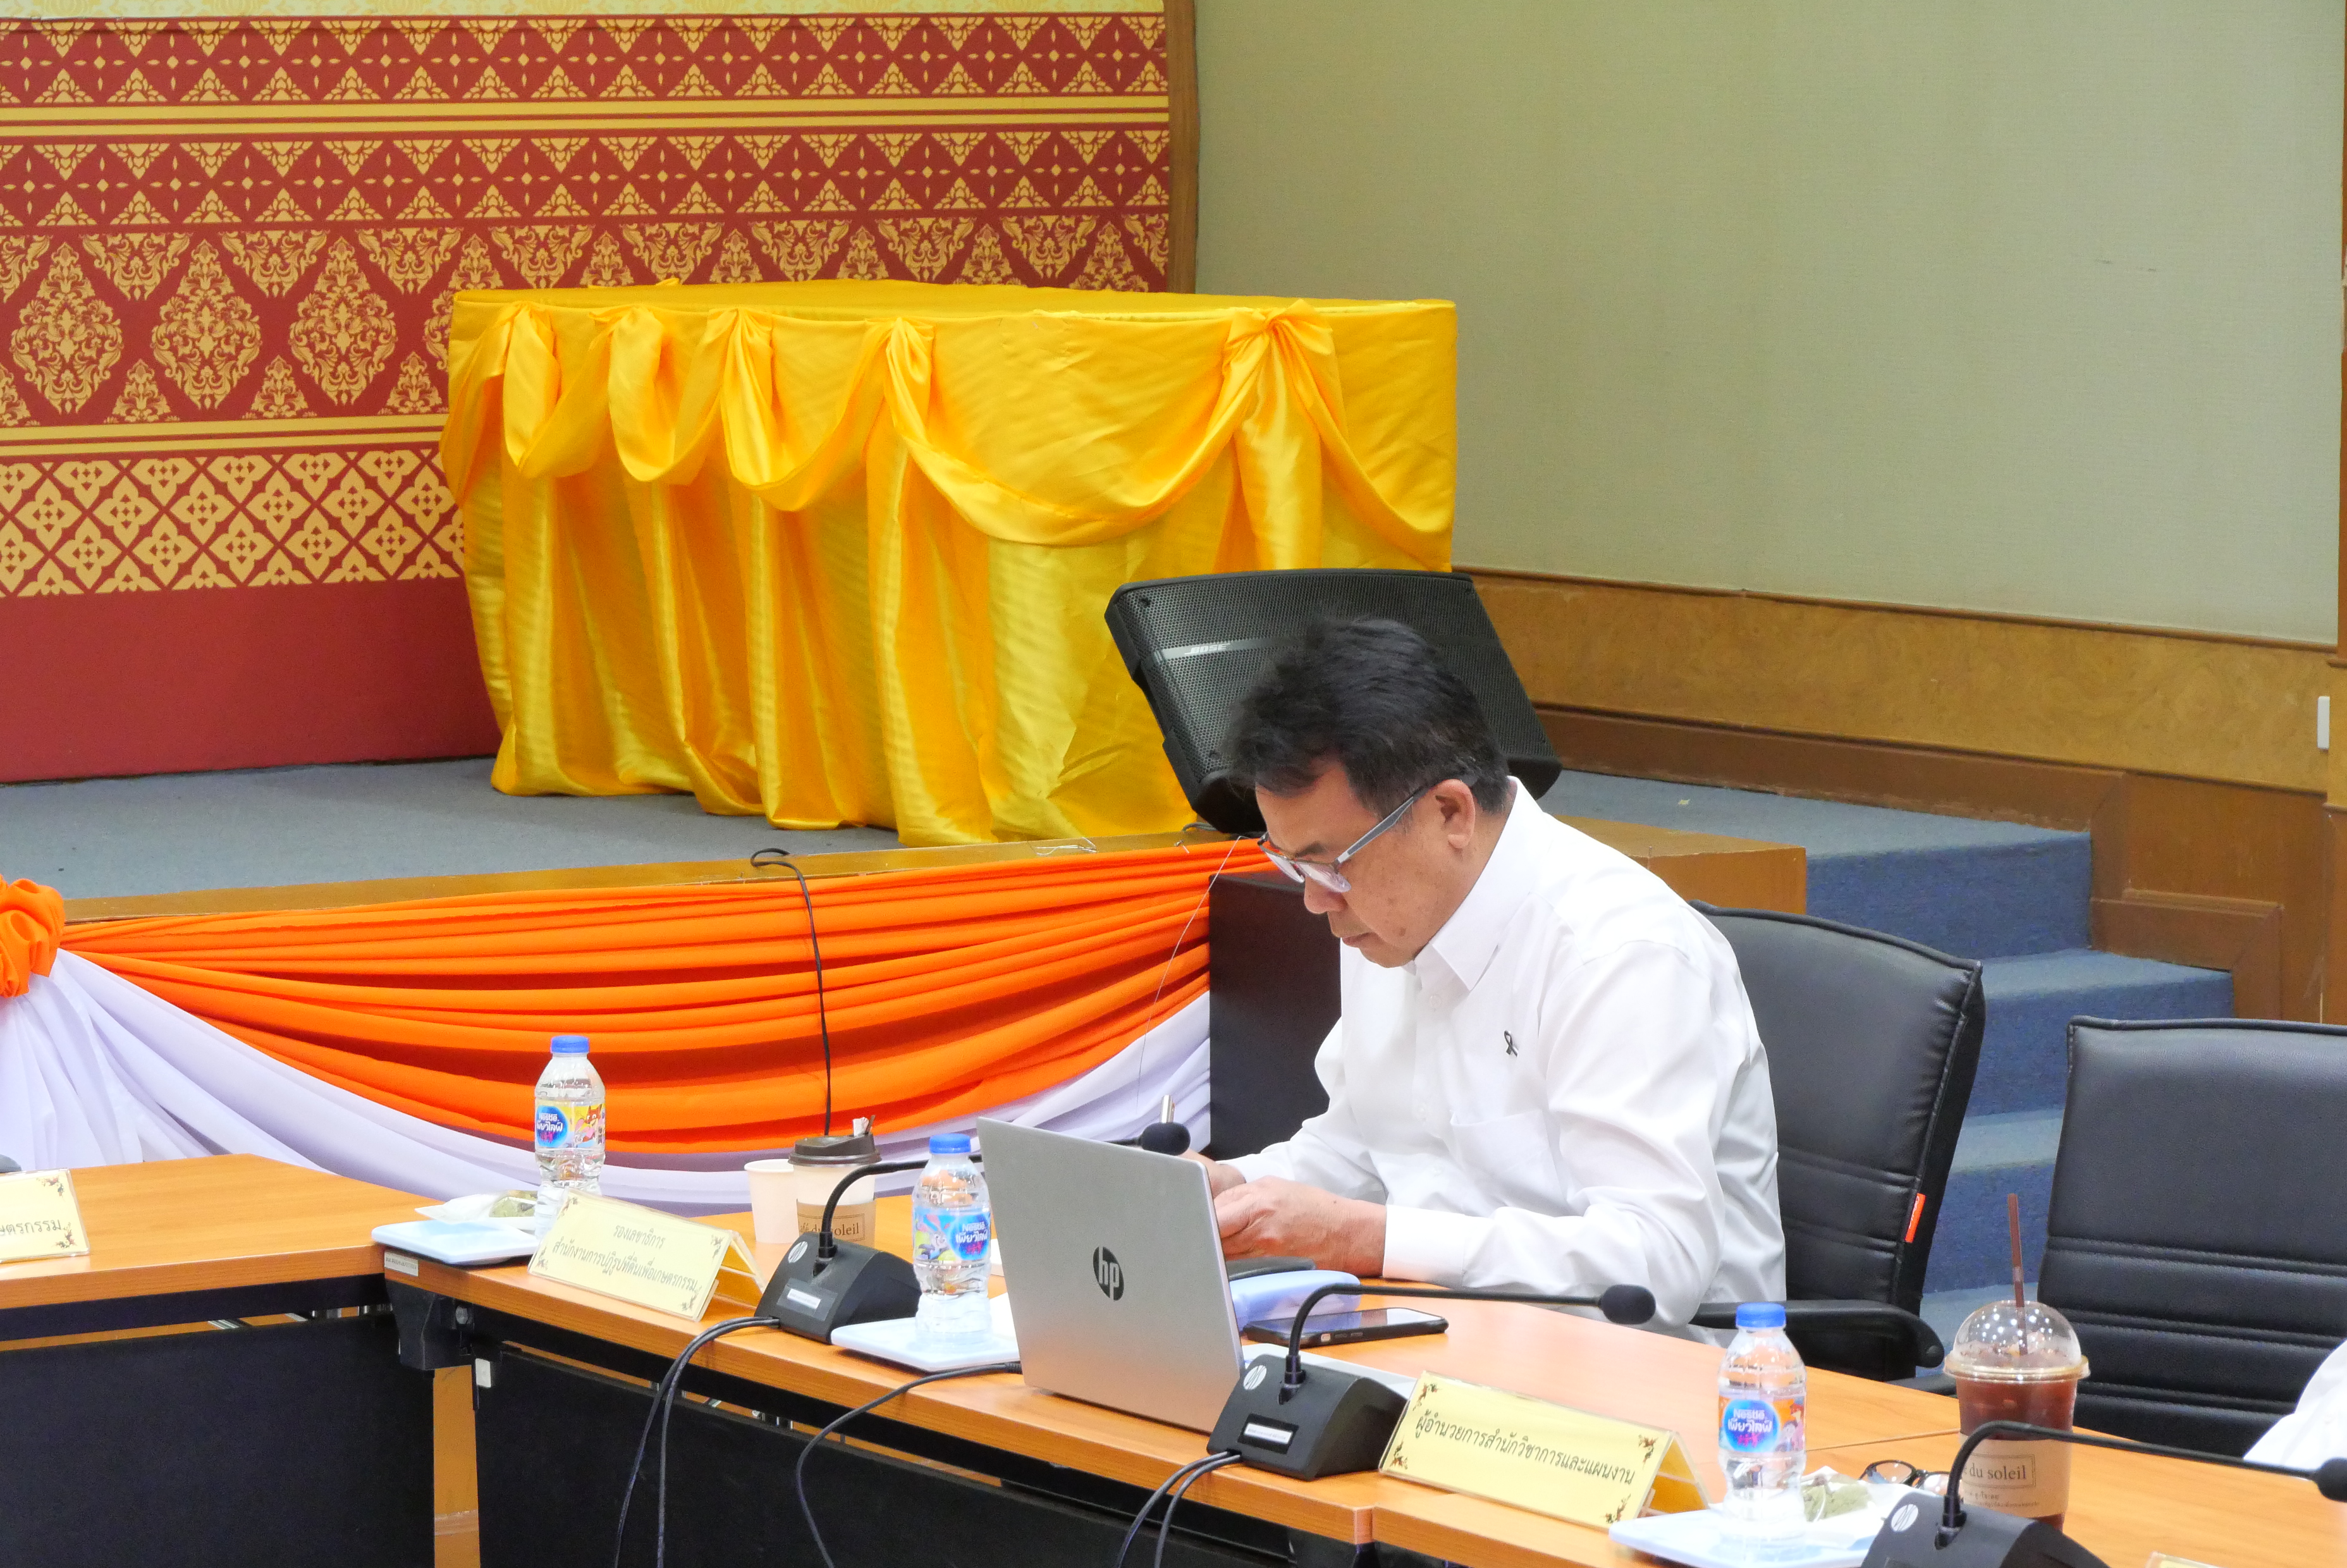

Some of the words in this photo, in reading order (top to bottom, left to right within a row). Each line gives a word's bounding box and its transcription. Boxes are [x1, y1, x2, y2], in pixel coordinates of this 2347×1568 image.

[1184, 643, 1231, 655] BOSE
[613, 1225, 666, 1249] รองเลขาธิการ
[831, 1222, 859, 1236] oleil
[552, 1235, 699, 1292] สำนักงานการปฏิรูปที่ดินเพื่อเกษตรกรรม
[1099, 1246, 1119, 1301] hp
[1415, 1409, 1635, 1485] ผู้อำนวยการสำนักวิชาการและแผนงาน
[1970, 1462, 1983, 1478] du
[1987, 1466, 2026, 1480] soleil
